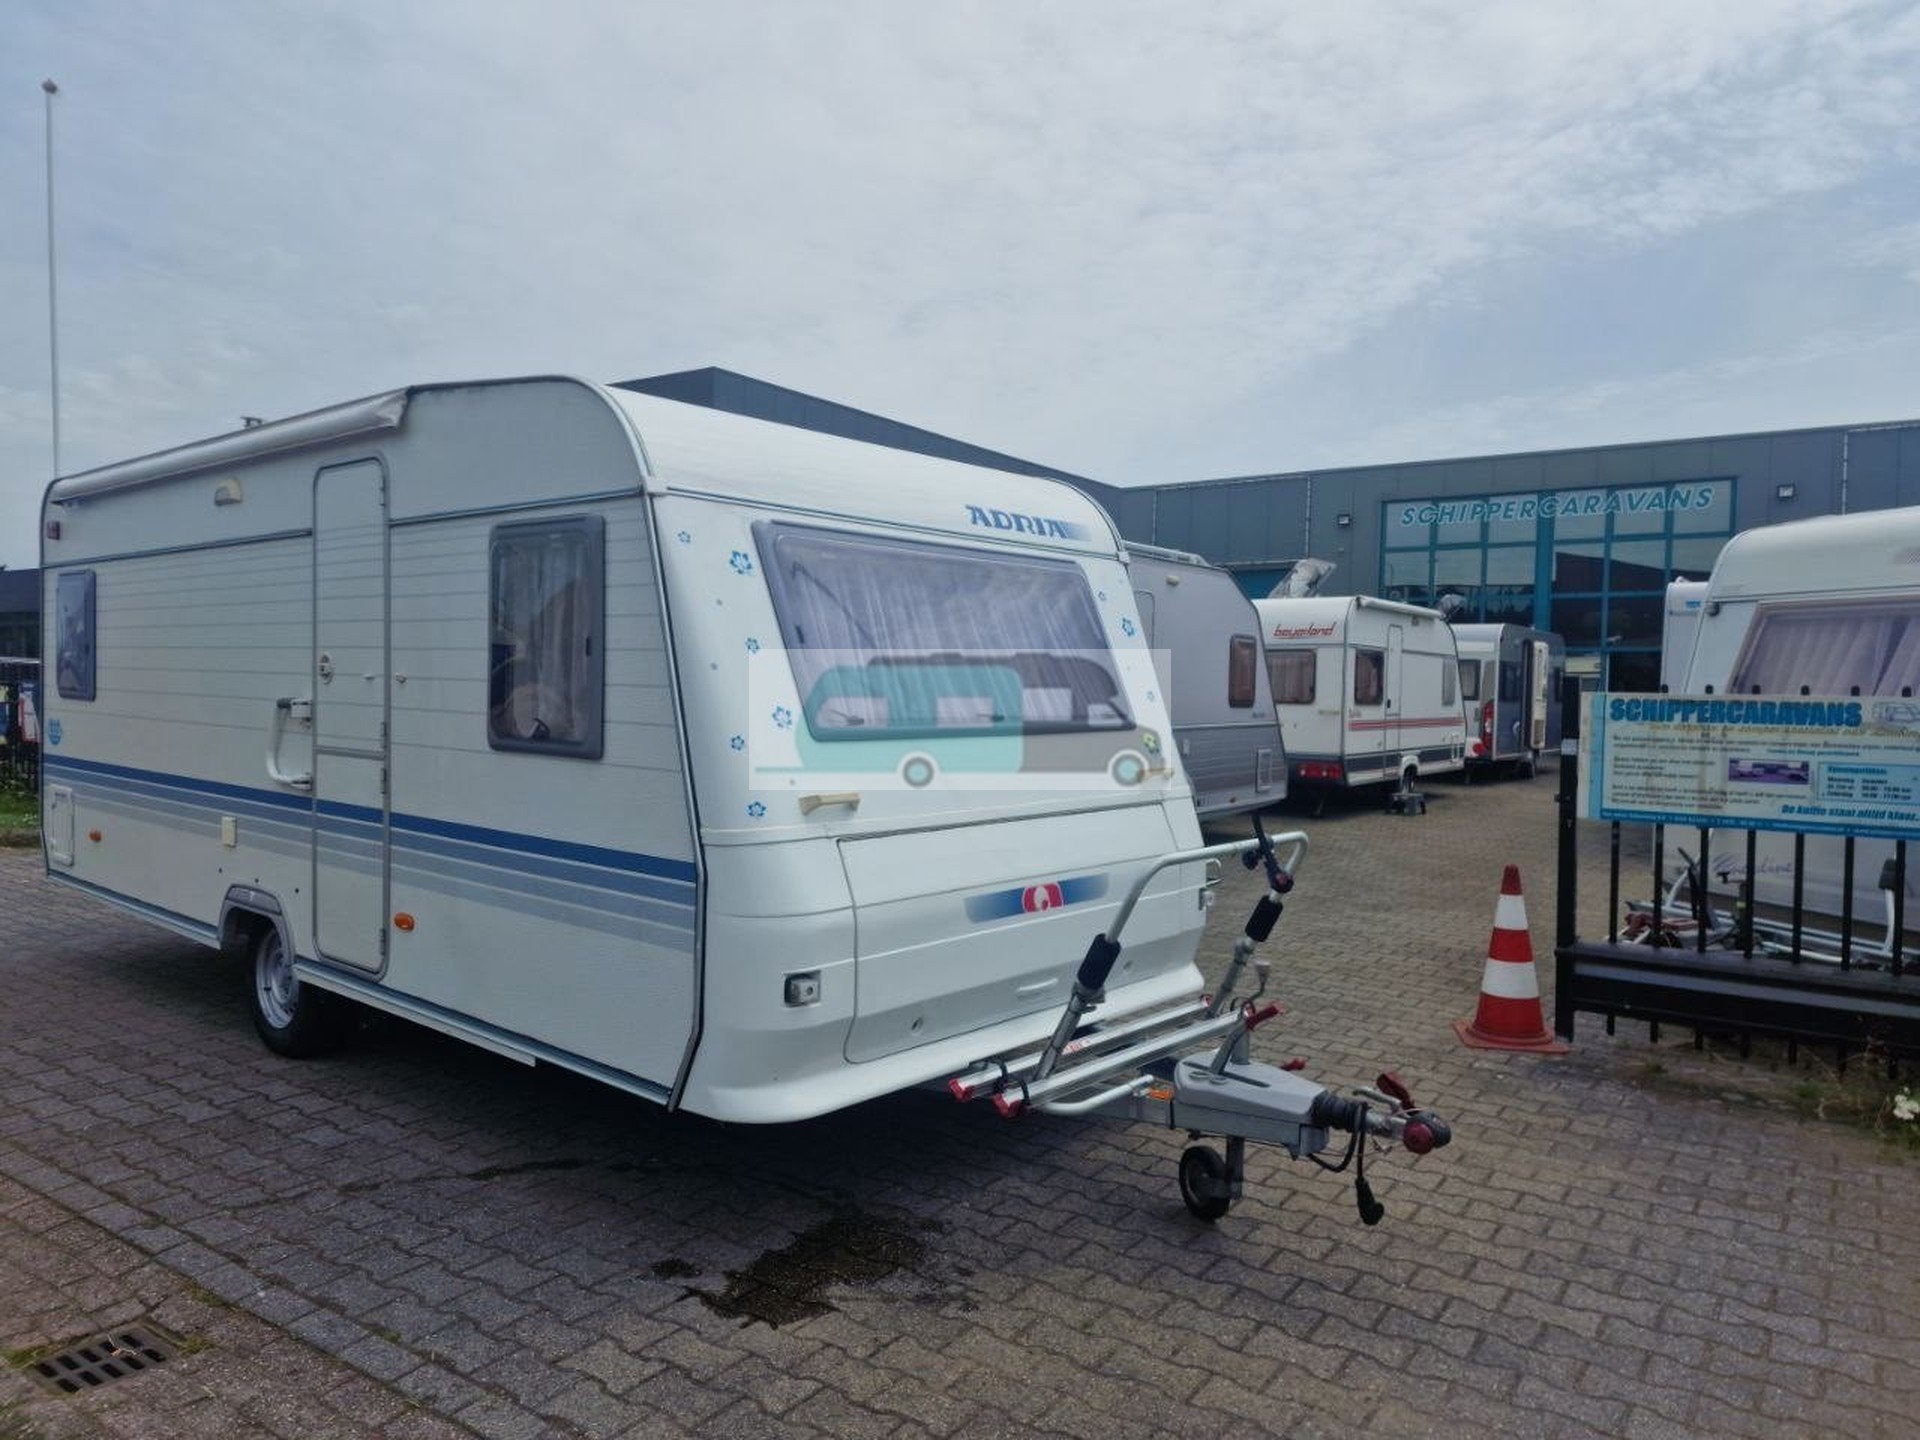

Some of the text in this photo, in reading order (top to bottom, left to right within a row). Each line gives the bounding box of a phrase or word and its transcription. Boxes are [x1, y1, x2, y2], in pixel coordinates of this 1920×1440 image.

[966, 504, 1068, 539] ADRIA
[1401, 486, 1715, 525] SCHIPPERCARAVANS
[1610, 698, 1863, 727] SCHIPPERCARAVANS
